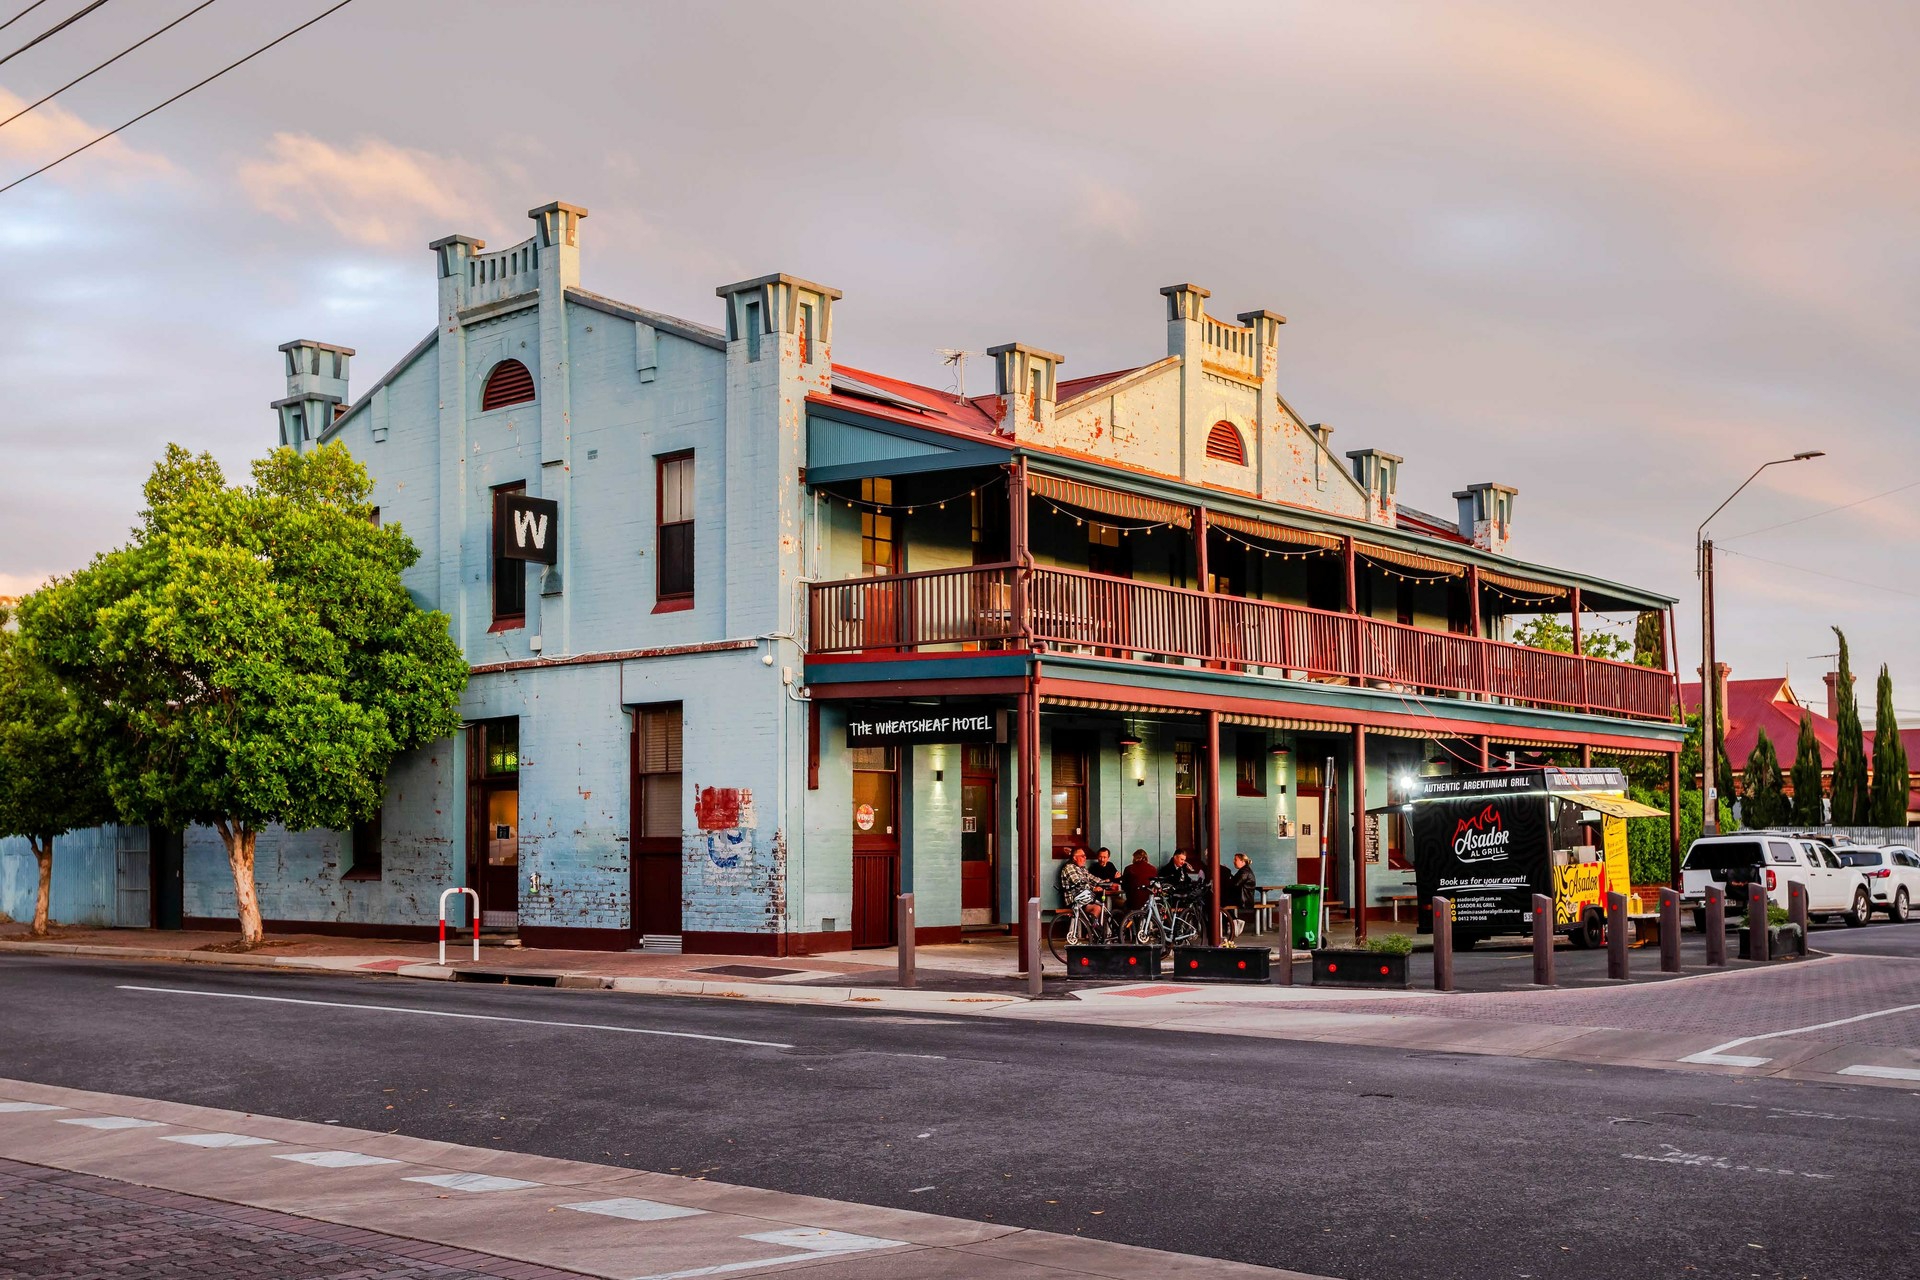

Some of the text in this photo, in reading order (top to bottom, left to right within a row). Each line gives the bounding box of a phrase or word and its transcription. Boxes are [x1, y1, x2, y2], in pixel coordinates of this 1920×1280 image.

[514, 510, 548, 549] W
[849, 715, 993, 736] THE WHEATSHEAF HOTEL
[1424, 777, 1530, 793] AUTHENTIC ARGENTINIAN GRILL
[1482, 846, 1505, 856] GRILL
[1440, 877, 1459, 886] Book
[1470, 877, 1482, 885] for
[1483, 879, 1501, 887] your
[1502, 875, 1527, 884] event!
